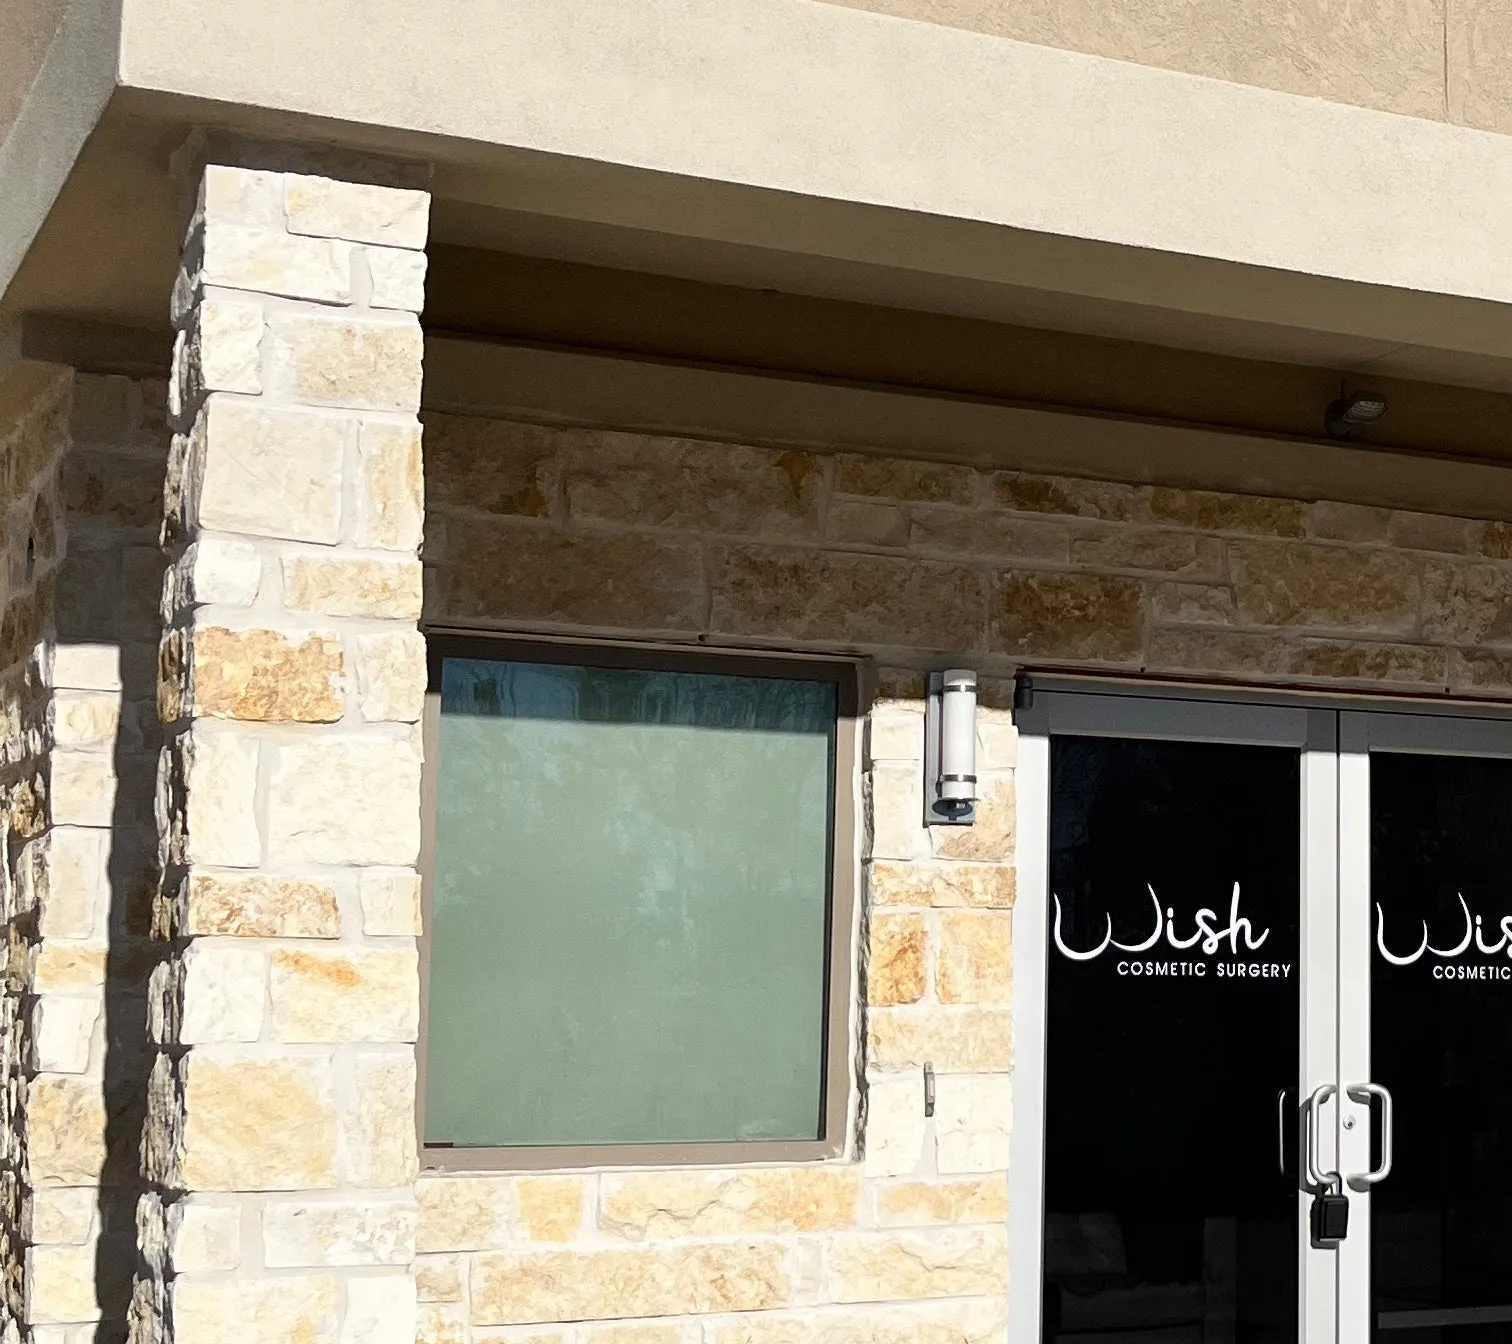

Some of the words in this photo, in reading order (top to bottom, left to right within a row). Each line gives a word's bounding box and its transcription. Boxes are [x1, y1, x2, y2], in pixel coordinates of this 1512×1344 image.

[1053, 881, 1270, 961] Wish
[1116, 960, 1207, 977] COSMETIC
[1216, 962, 1291, 978] SURGERY
[1432, 965, 1512, 980] COSMETIC
